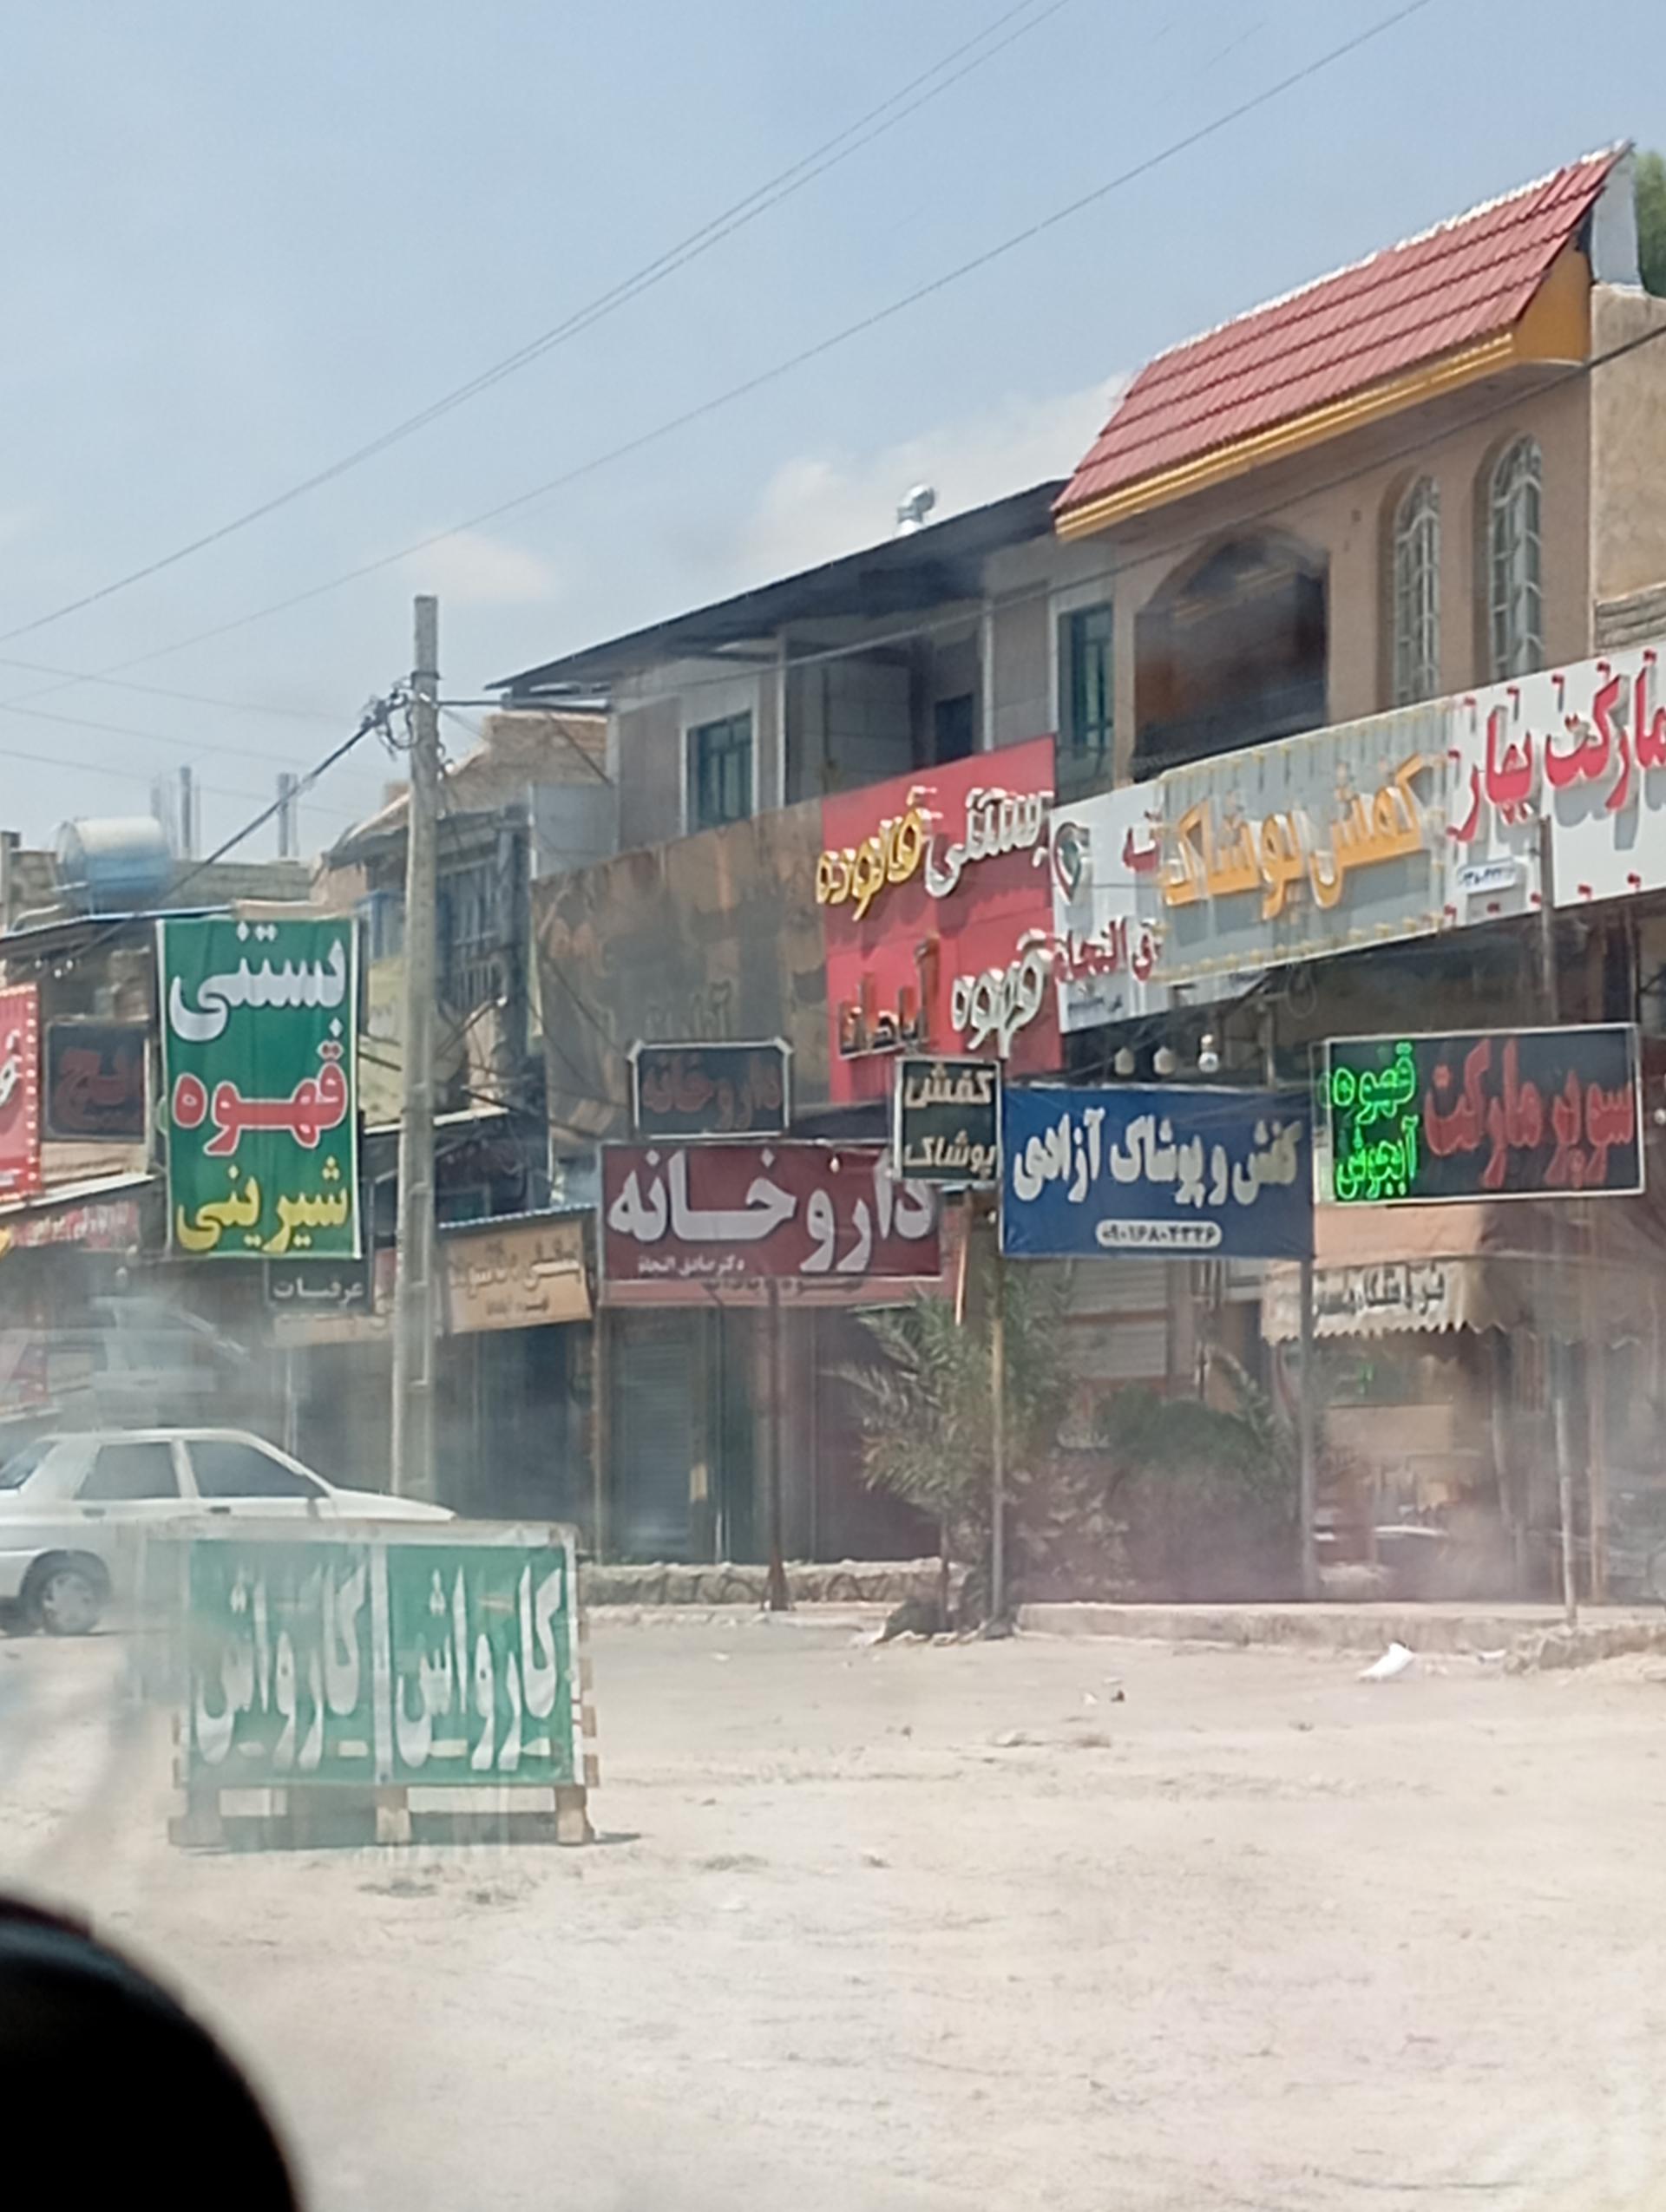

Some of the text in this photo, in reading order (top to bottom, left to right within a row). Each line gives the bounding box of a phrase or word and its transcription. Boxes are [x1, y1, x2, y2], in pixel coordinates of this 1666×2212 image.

[816, 785, 935, 921] فالوده
[924, 787, 1054, 899] بستنی
[1309, 751, 1425, 907] کفش
[169, 921, 346, 1042] بستنی
[951, 928, 1062, 1060] قهوه
[173, 1041, 348, 1155] قهوه
[904, 1063, 994, 1108] کفش
[1333, 1042, 1415, 1125] قهوه
[176, 1155, 348, 1253] شیرینی
[608, 1149, 935, 1273] داروخانه
[904, 1129, 997, 1180] پوشاک
[1013, 1107, 1302, 1208] کفش و پوشاک آزادی
[196, 1562, 366, 1770] کارواش
[395, 1563, 562, 1771] کارواش
